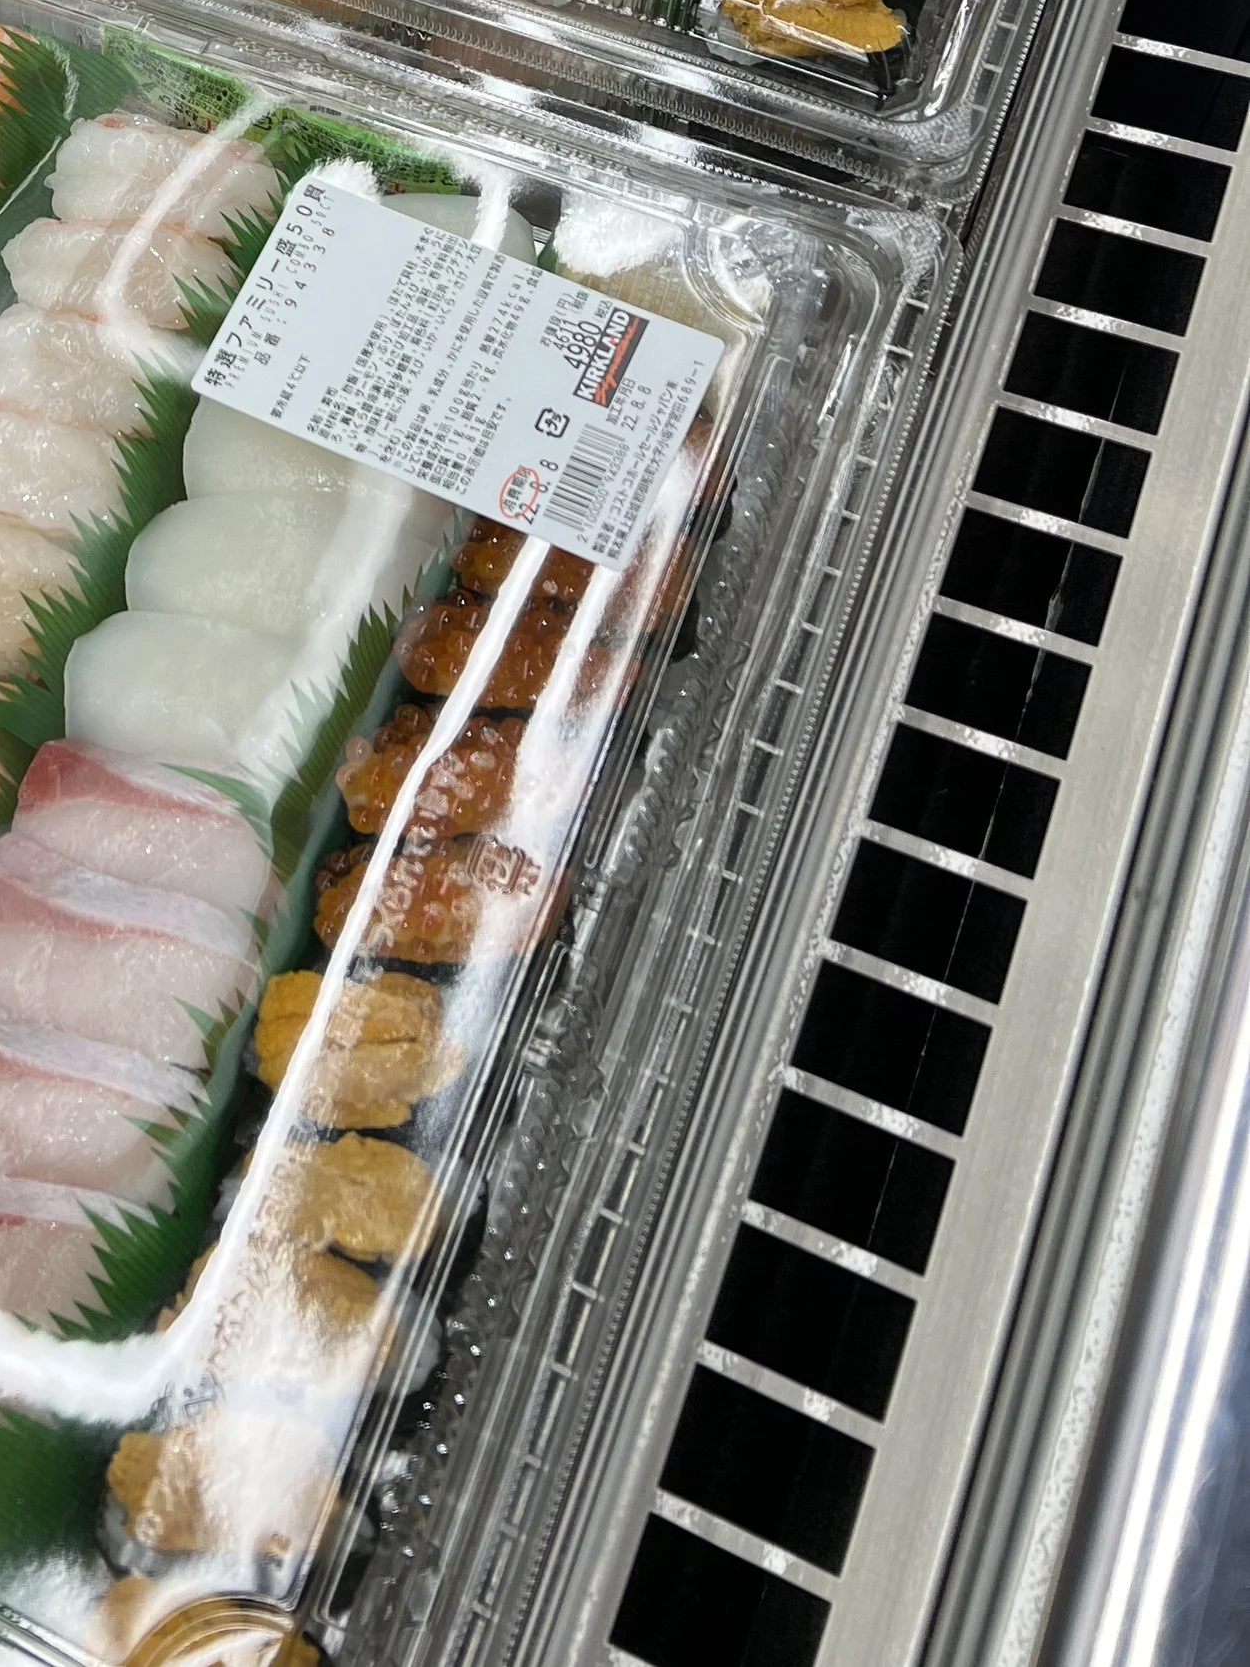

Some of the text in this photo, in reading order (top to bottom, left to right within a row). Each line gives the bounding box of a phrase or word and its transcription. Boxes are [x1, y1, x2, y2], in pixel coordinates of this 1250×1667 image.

[201, 183, 326, 388] 特選ファミリー盛50貫
[258, 281, 289, 322] SUSHI
[284, 233, 315, 274] COMBO
[550, 318, 577, 351] 4611
[559, 318, 604, 370] 4980
[574, 308, 633, 400] KIRKLAND
[603, 376, 637, 425] 加工年月日
[619, 383, 653, 431] 22. 8. 8
[498, 463, 534, 512] 消費期限
[514, 457, 560, 524] 22. 8. 8
